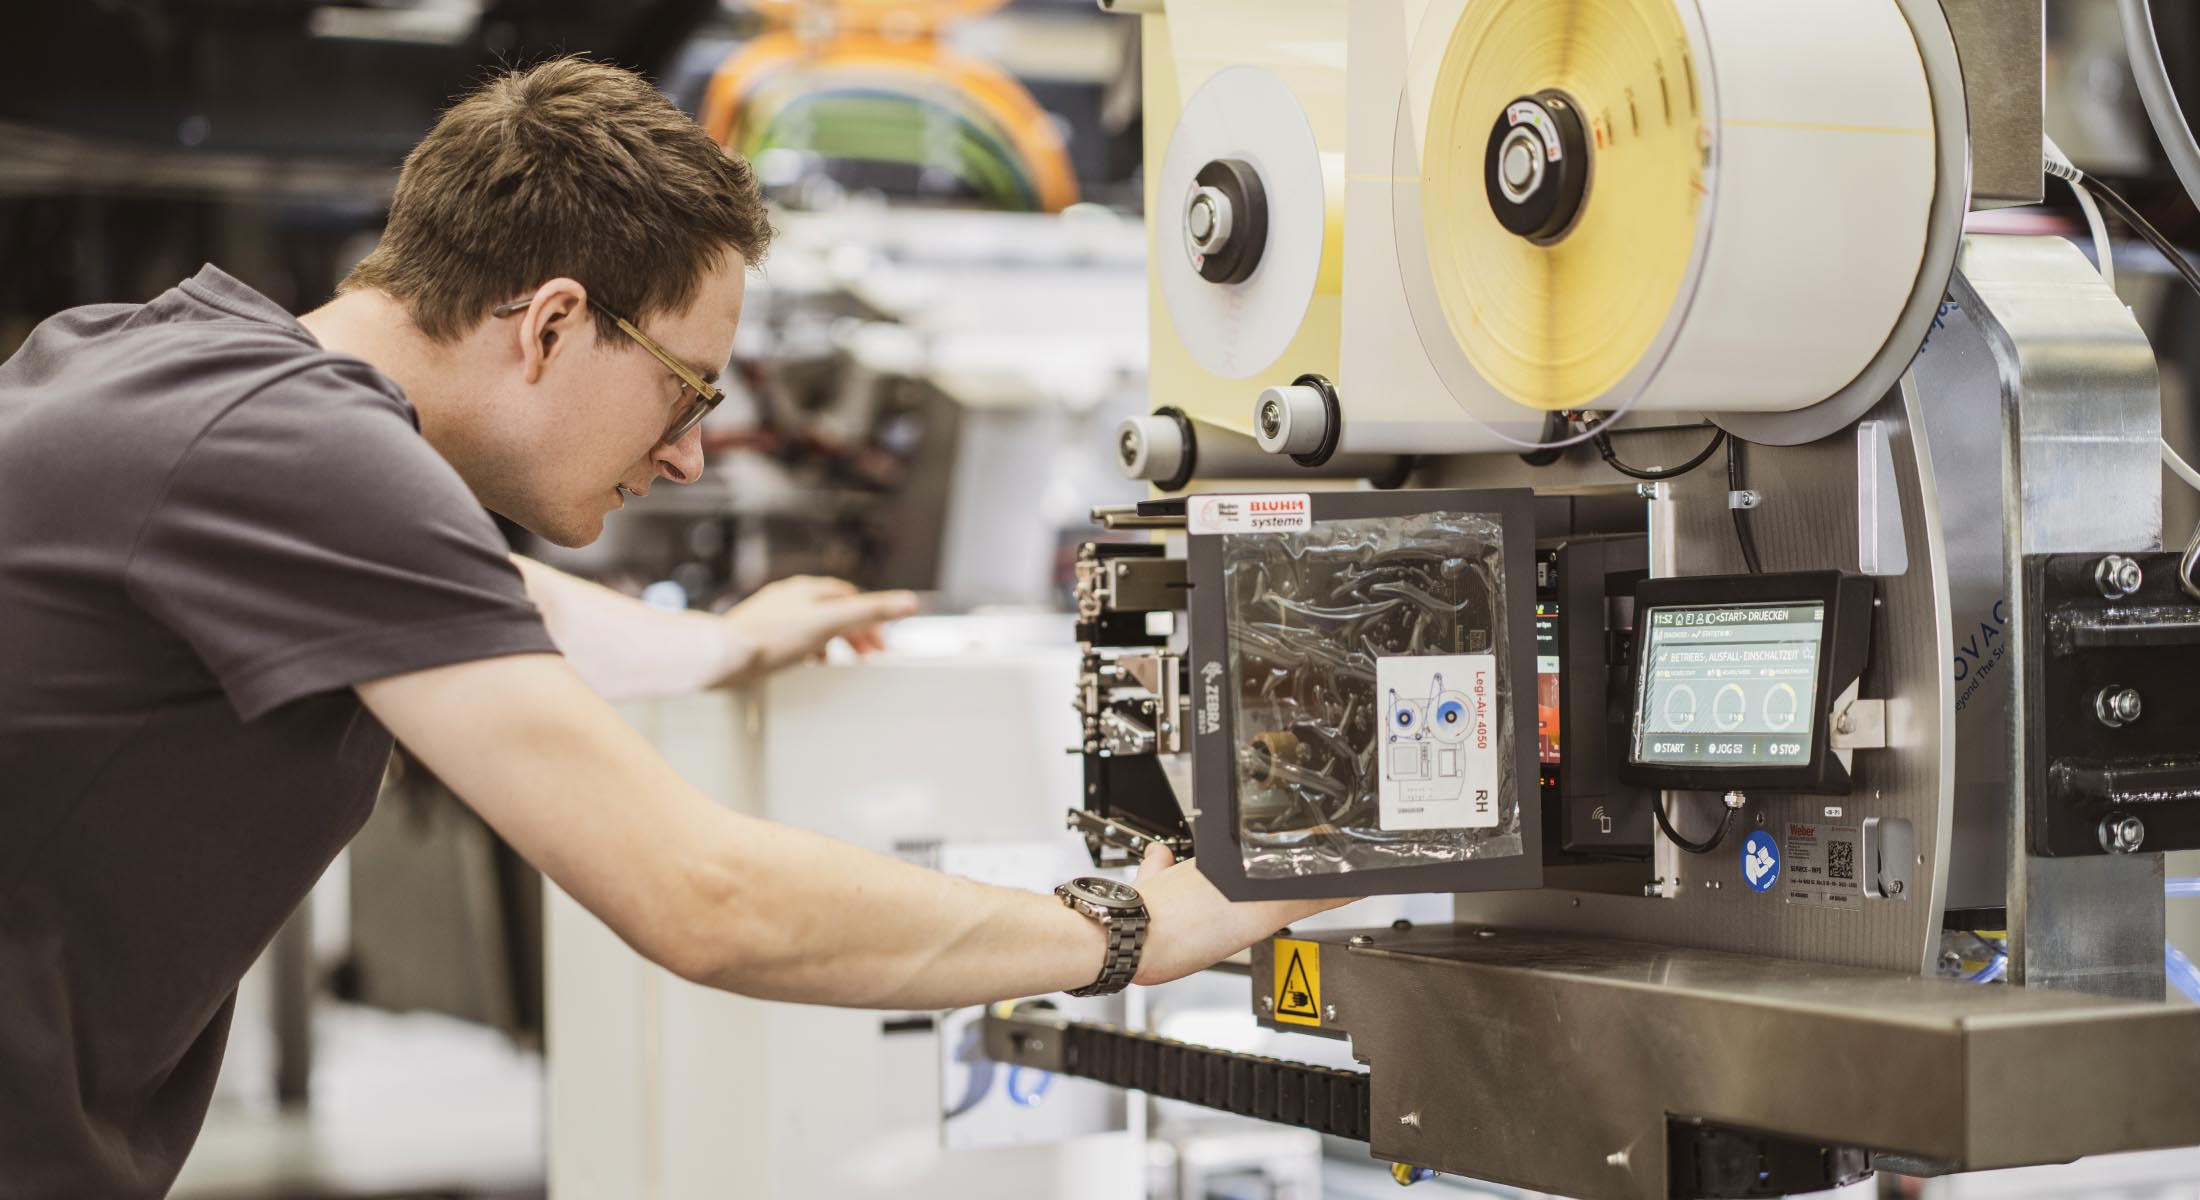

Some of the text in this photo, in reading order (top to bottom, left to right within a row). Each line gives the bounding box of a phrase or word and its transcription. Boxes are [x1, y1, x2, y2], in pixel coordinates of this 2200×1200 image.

[1250, 500, 1304, 512] BLUHM
[1251, 517, 1304, 529] systeme
[1654, 610, 1789, 624] 11:52 <START> DRUECKEN
[1743, 650, 1798, 661] EINSCHALTZEIT
[1955, 645, 2006, 711] eyond The Su
[1205, 685, 1220, 734] ZEBRA
[1474, 671, 1488, 750] Legi-Air 4050
[1661, 743, 1685, 753] START
[1716, 743, 1733, 754] JOG
[1779, 743, 1801, 755] STOP
[1475, 789, 1489, 813] RH
[1790, 824, 1815, 836] Weber
